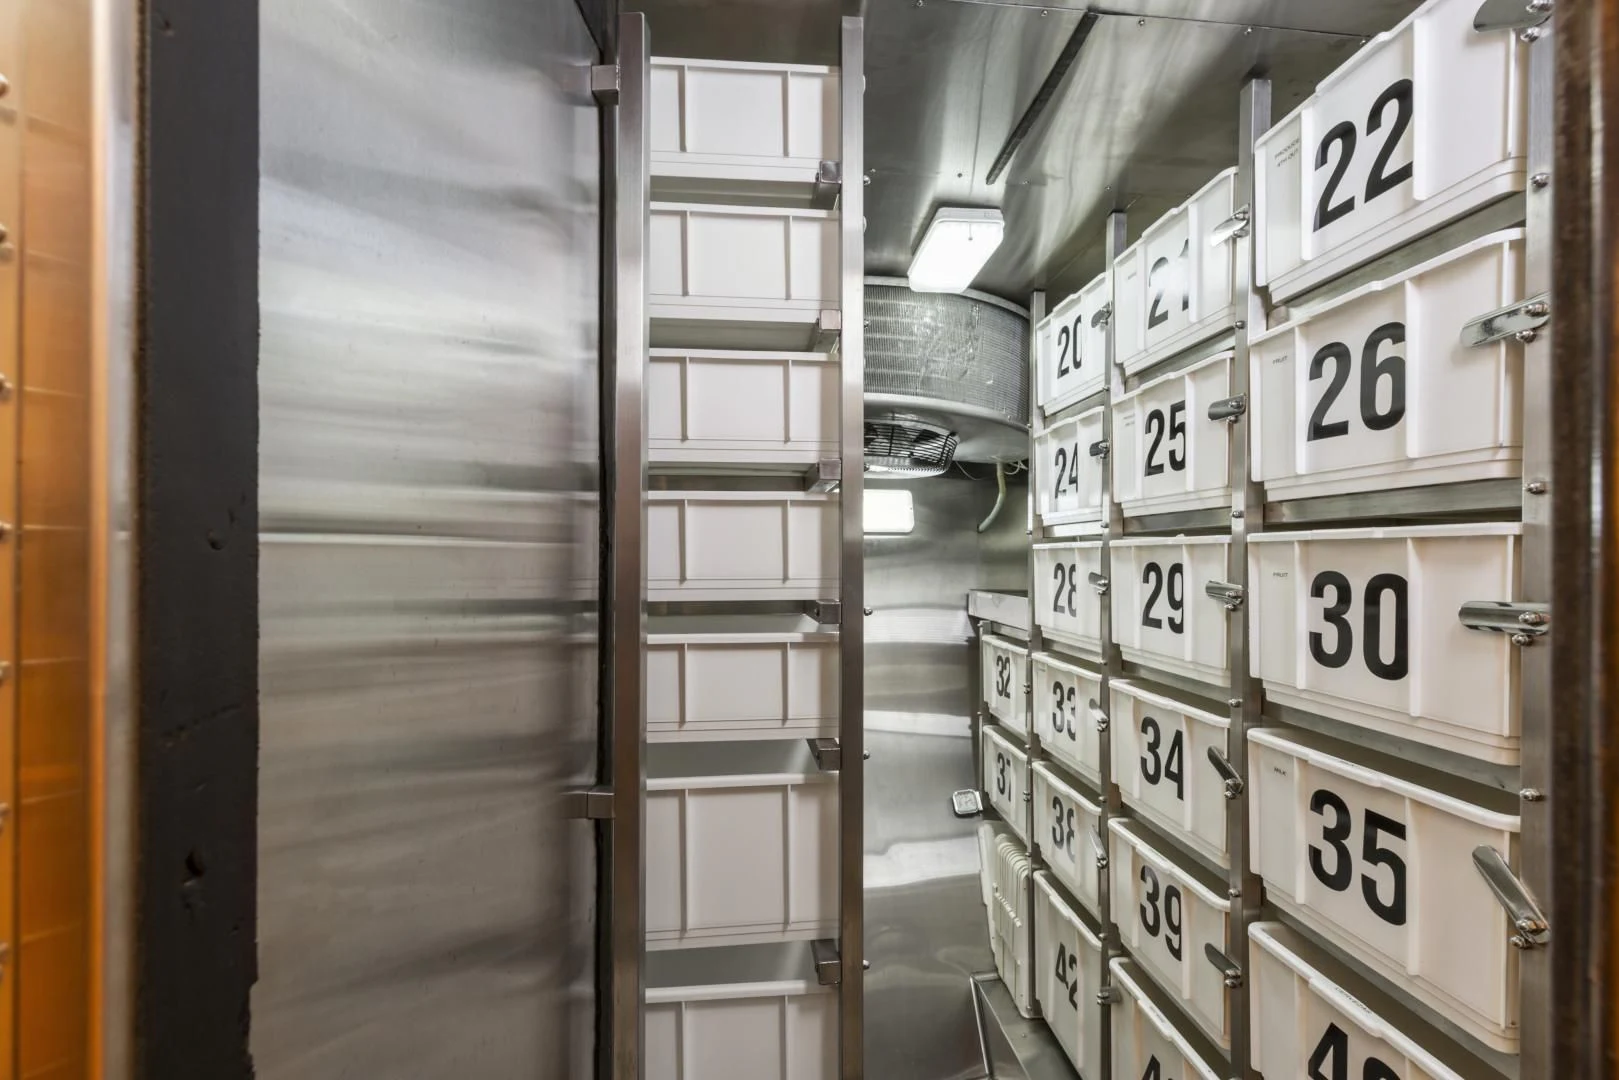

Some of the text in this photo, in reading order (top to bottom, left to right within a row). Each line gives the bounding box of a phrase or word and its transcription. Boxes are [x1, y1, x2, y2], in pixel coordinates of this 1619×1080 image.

[1313, 78, 1413, 232] 22
[1057, 314, 1081, 379] 20
[1307, 321, 1405, 441] 26
[1055, 442, 1078, 499] 24
[1145, 400, 1185, 476] 25
[1053, 562, 1076, 617] 28
[1142, 562, 1184, 634] 29
[1309, 570, 1408, 680] 30
[996, 656, 1010, 699] 32
[1053, 681, 1076, 741] 33
[1141, 717, 1183, 800] 34
[1052, 796, 1075, 864] 38
[1308, 790, 1406, 926] 35
[1140, 865, 1182, 961] 39
[1055, 942, 1077, 1011] 42
[1308, 1022, 1400, 1080] 4
